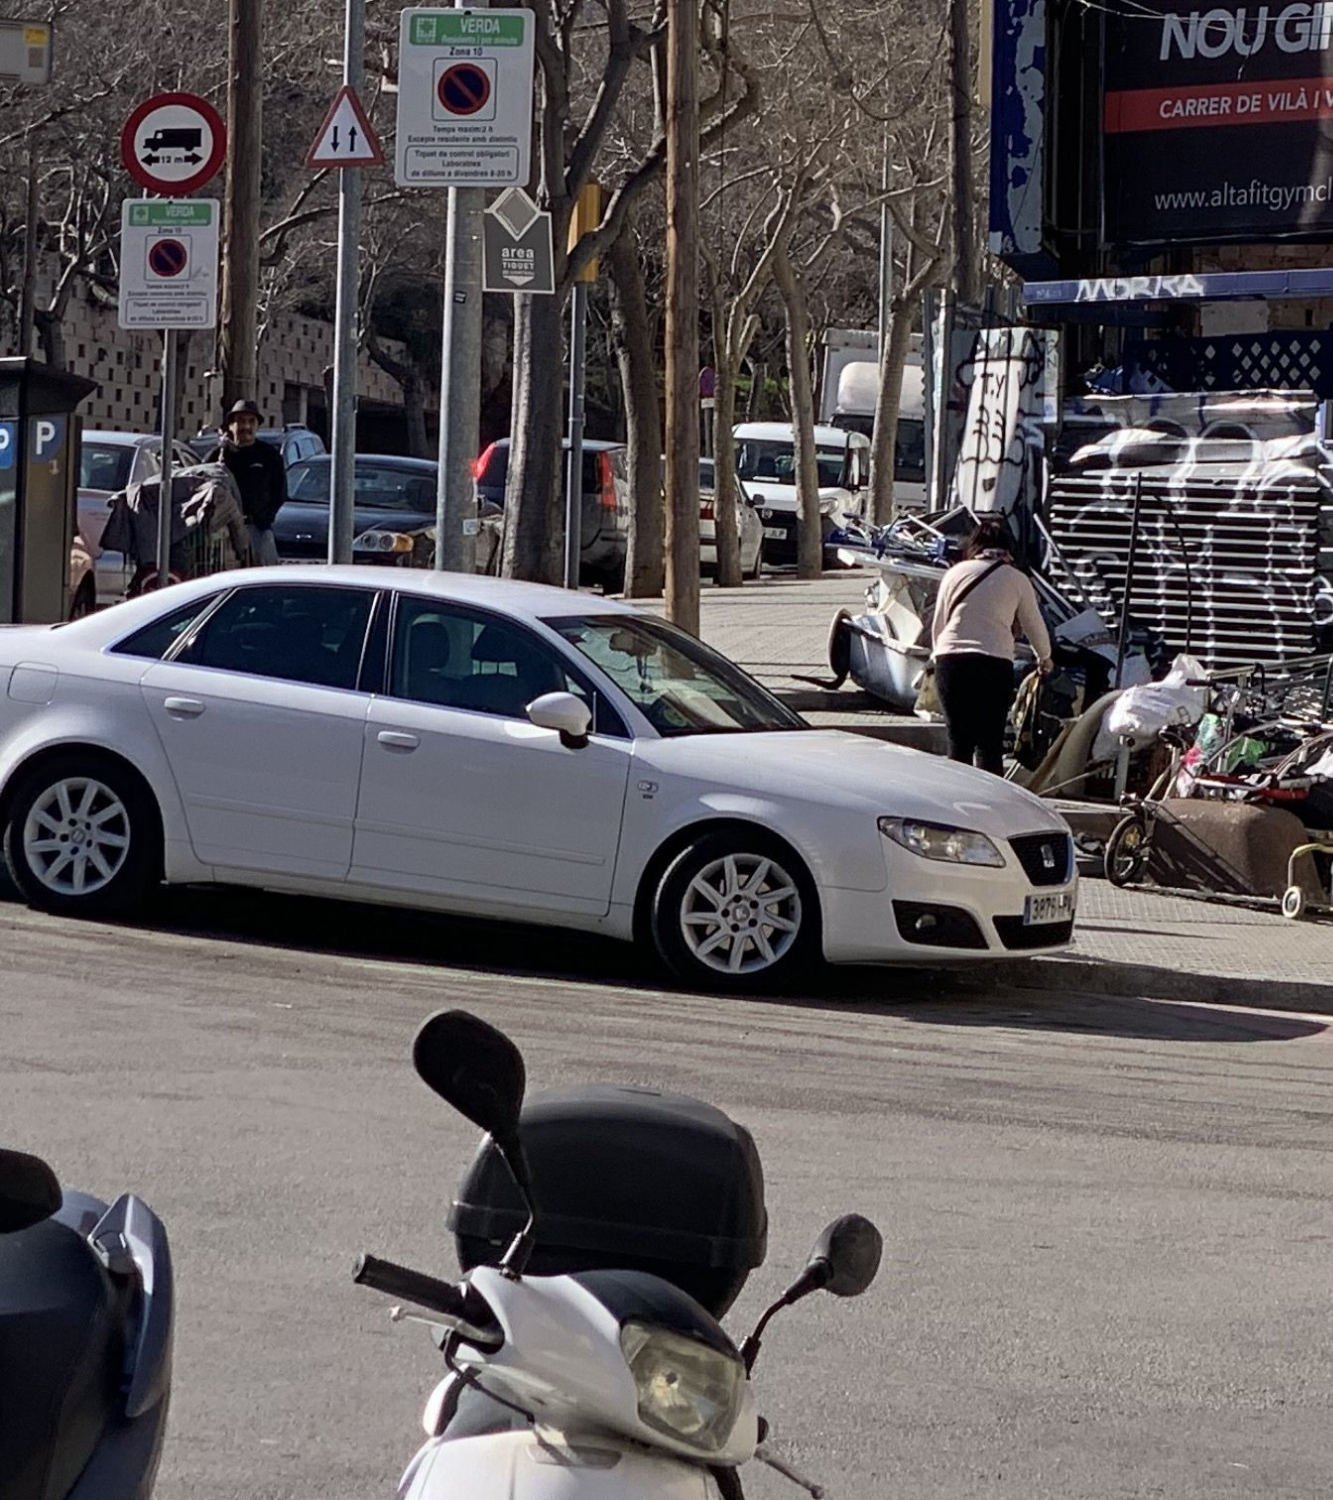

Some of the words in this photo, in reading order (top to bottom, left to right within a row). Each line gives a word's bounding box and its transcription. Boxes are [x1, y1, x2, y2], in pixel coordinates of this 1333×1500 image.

[460, 18, 501, 34] VERDA
[1159, 5, 1267, 62] NOU
[1159, 96, 1231, 119] CARRER
[1236, 94, 1263, 114] DE
[1268, 86, 1308, 112] VILÀ
[501, 247, 535, 258] area
[36, 421, 56, 455] P
